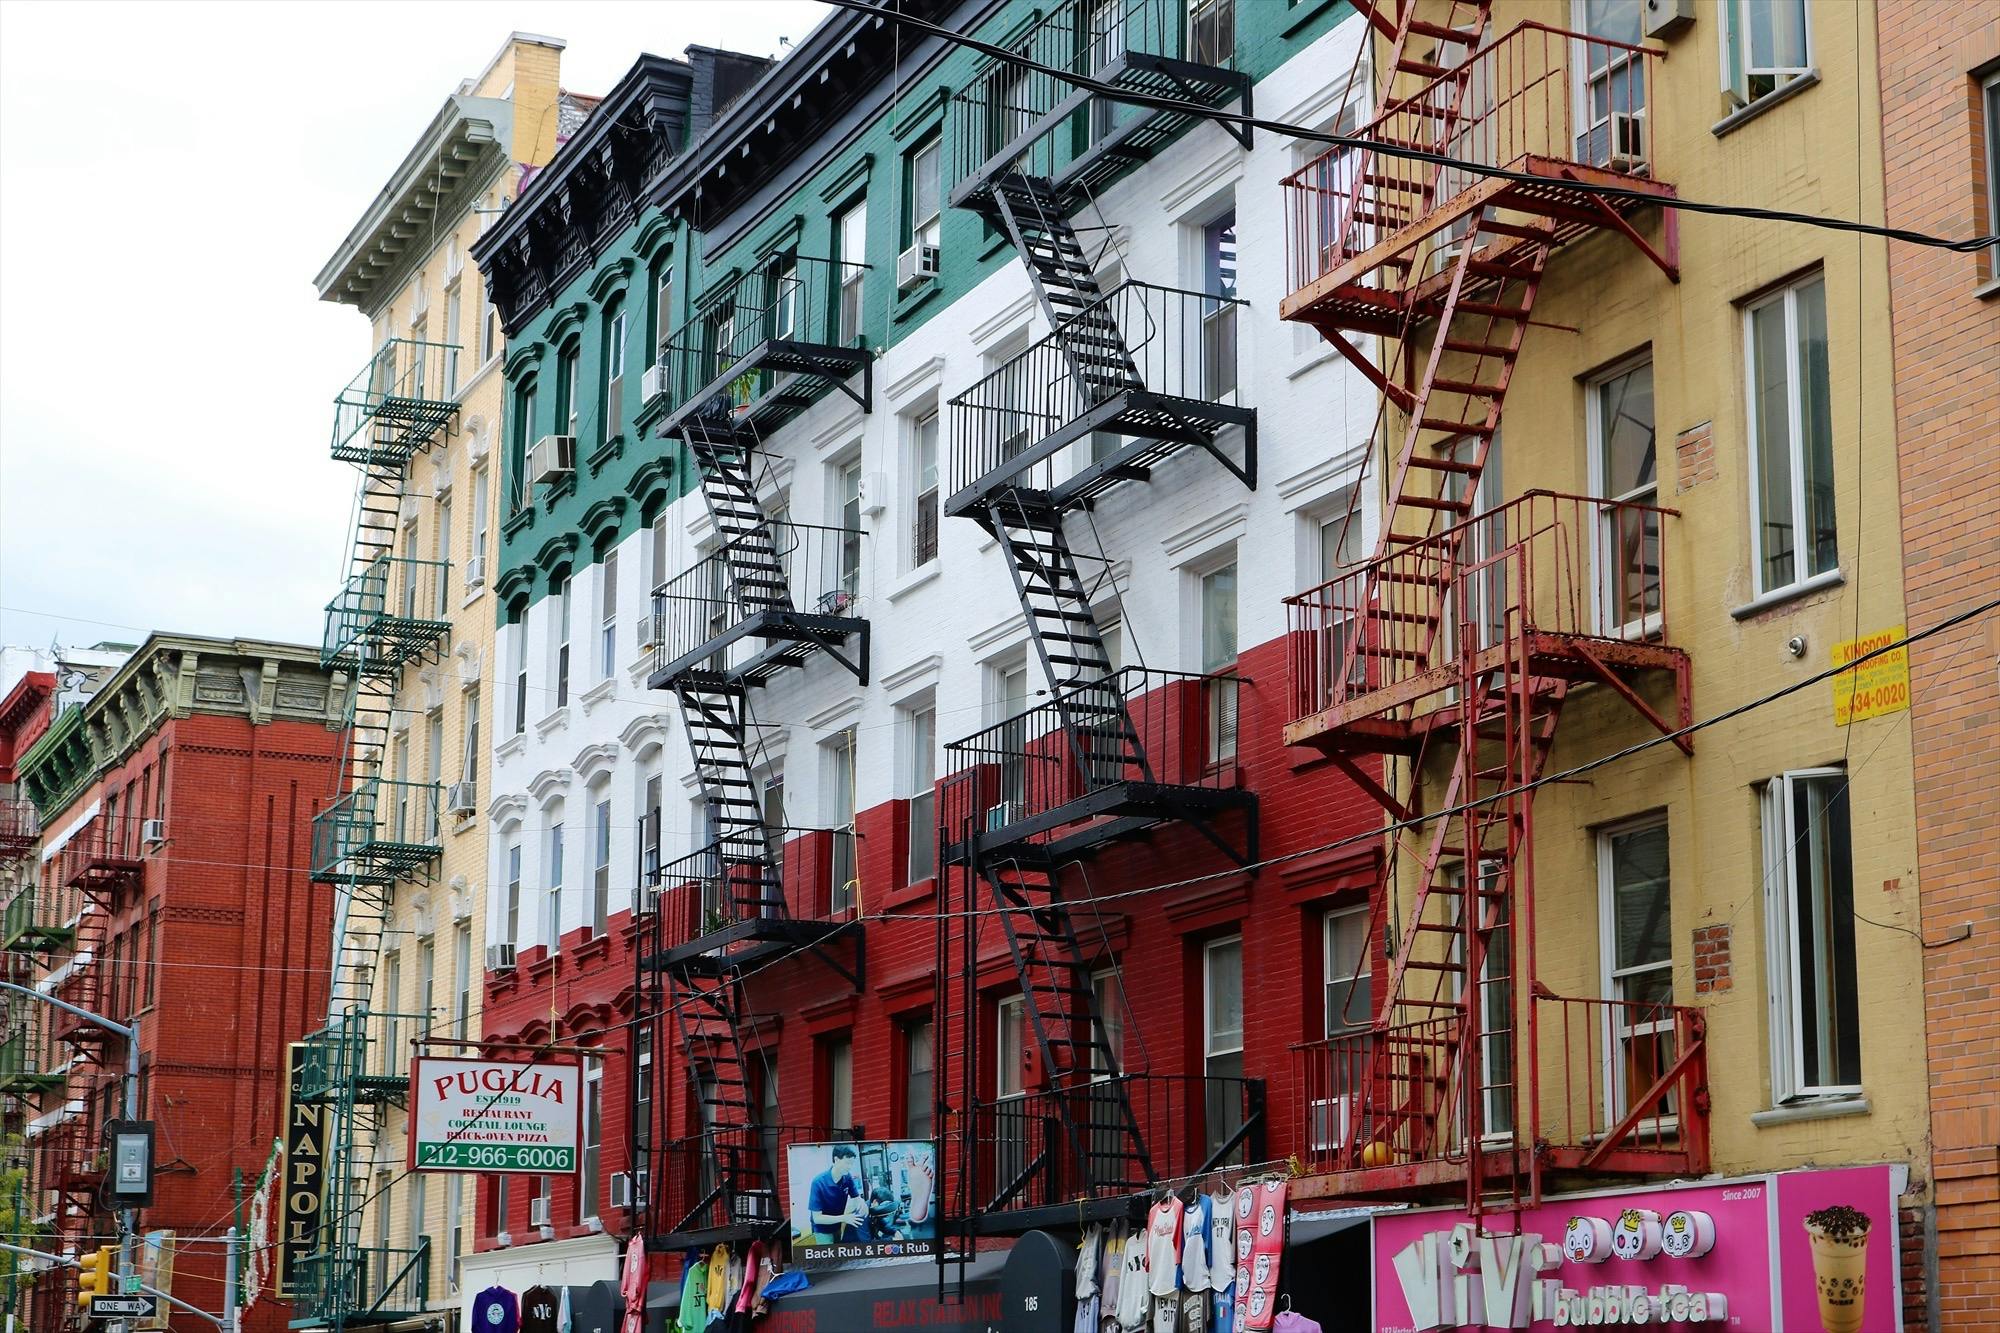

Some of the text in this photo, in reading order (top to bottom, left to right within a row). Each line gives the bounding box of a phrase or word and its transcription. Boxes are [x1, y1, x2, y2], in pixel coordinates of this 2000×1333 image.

[1843, 634, 1891, 662] KINGDOM
[1891, 651, 1903, 662] CO.
[433, 1069, 564, 1104] PUGLIA
[463, 1109, 533, 1120] RESTAURANT
[448, 1119, 548, 1131] COCKTAIL LOUNGE
[447, 1131, 548, 1143] BRICK-OVEN PIZZA
[425, 1145, 568, 1168] 212-966-6006
[290, 1104, 321, 1272] NAPOLI
[1722, 1187, 1761, 1201] Since 2007
[805, 1248, 835, 1260] Back
[838, 1246, 862, 1258] Rub
[865, 1245, 874, 1256] &
[906, 1242, 930, 1253] Rub
[99, 1302, 147, 1311] ONE WAY
[533, 1303, 551, 1320] NYC
[1024, 1296, 1038, 1312] 185
[1553, 1285, 1711, 1327] bubble tea
[873, 1300, 917, 1328] RELAX
[1731, 1316, 1741, 1325] TM
